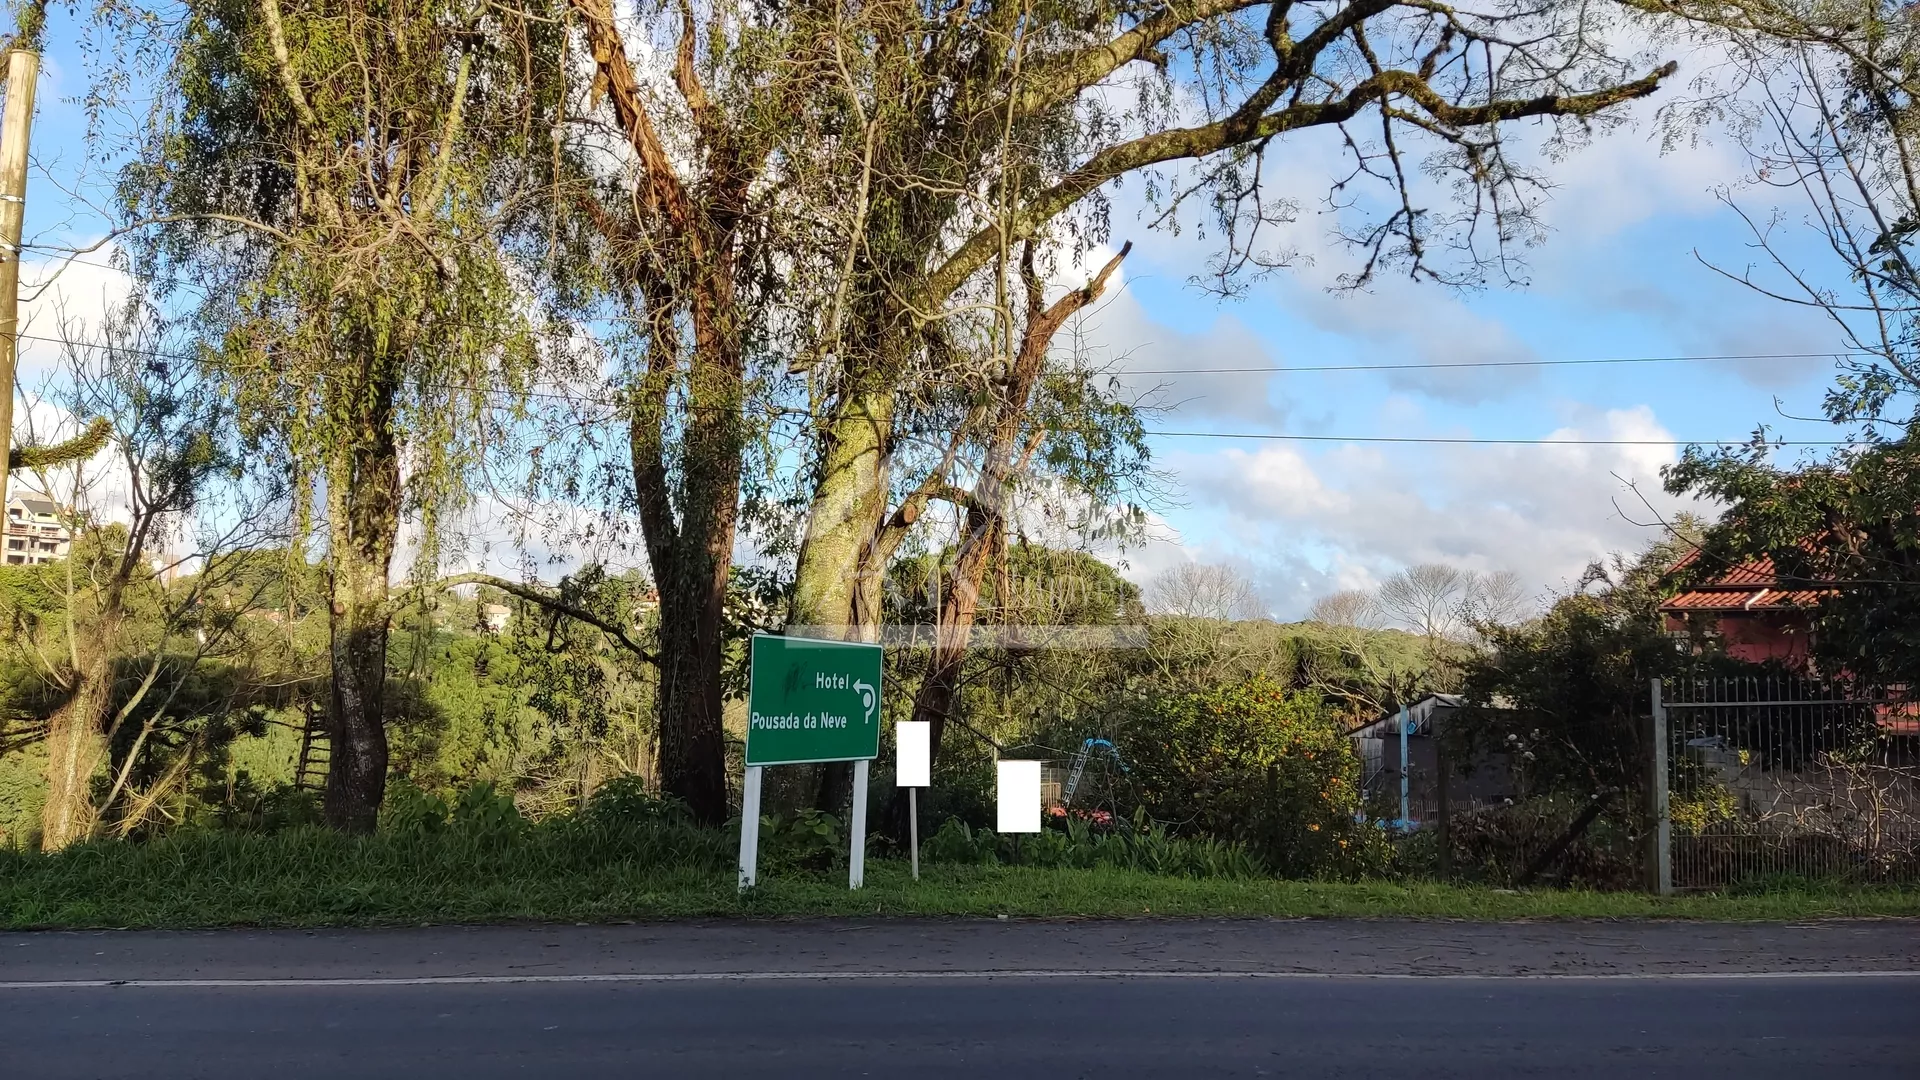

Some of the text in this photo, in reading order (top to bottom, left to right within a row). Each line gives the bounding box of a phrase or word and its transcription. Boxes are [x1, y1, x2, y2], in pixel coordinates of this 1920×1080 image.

[816, 672, 849, 690] Hotel
[751, 712, 847, 730] Pousada da Neve
